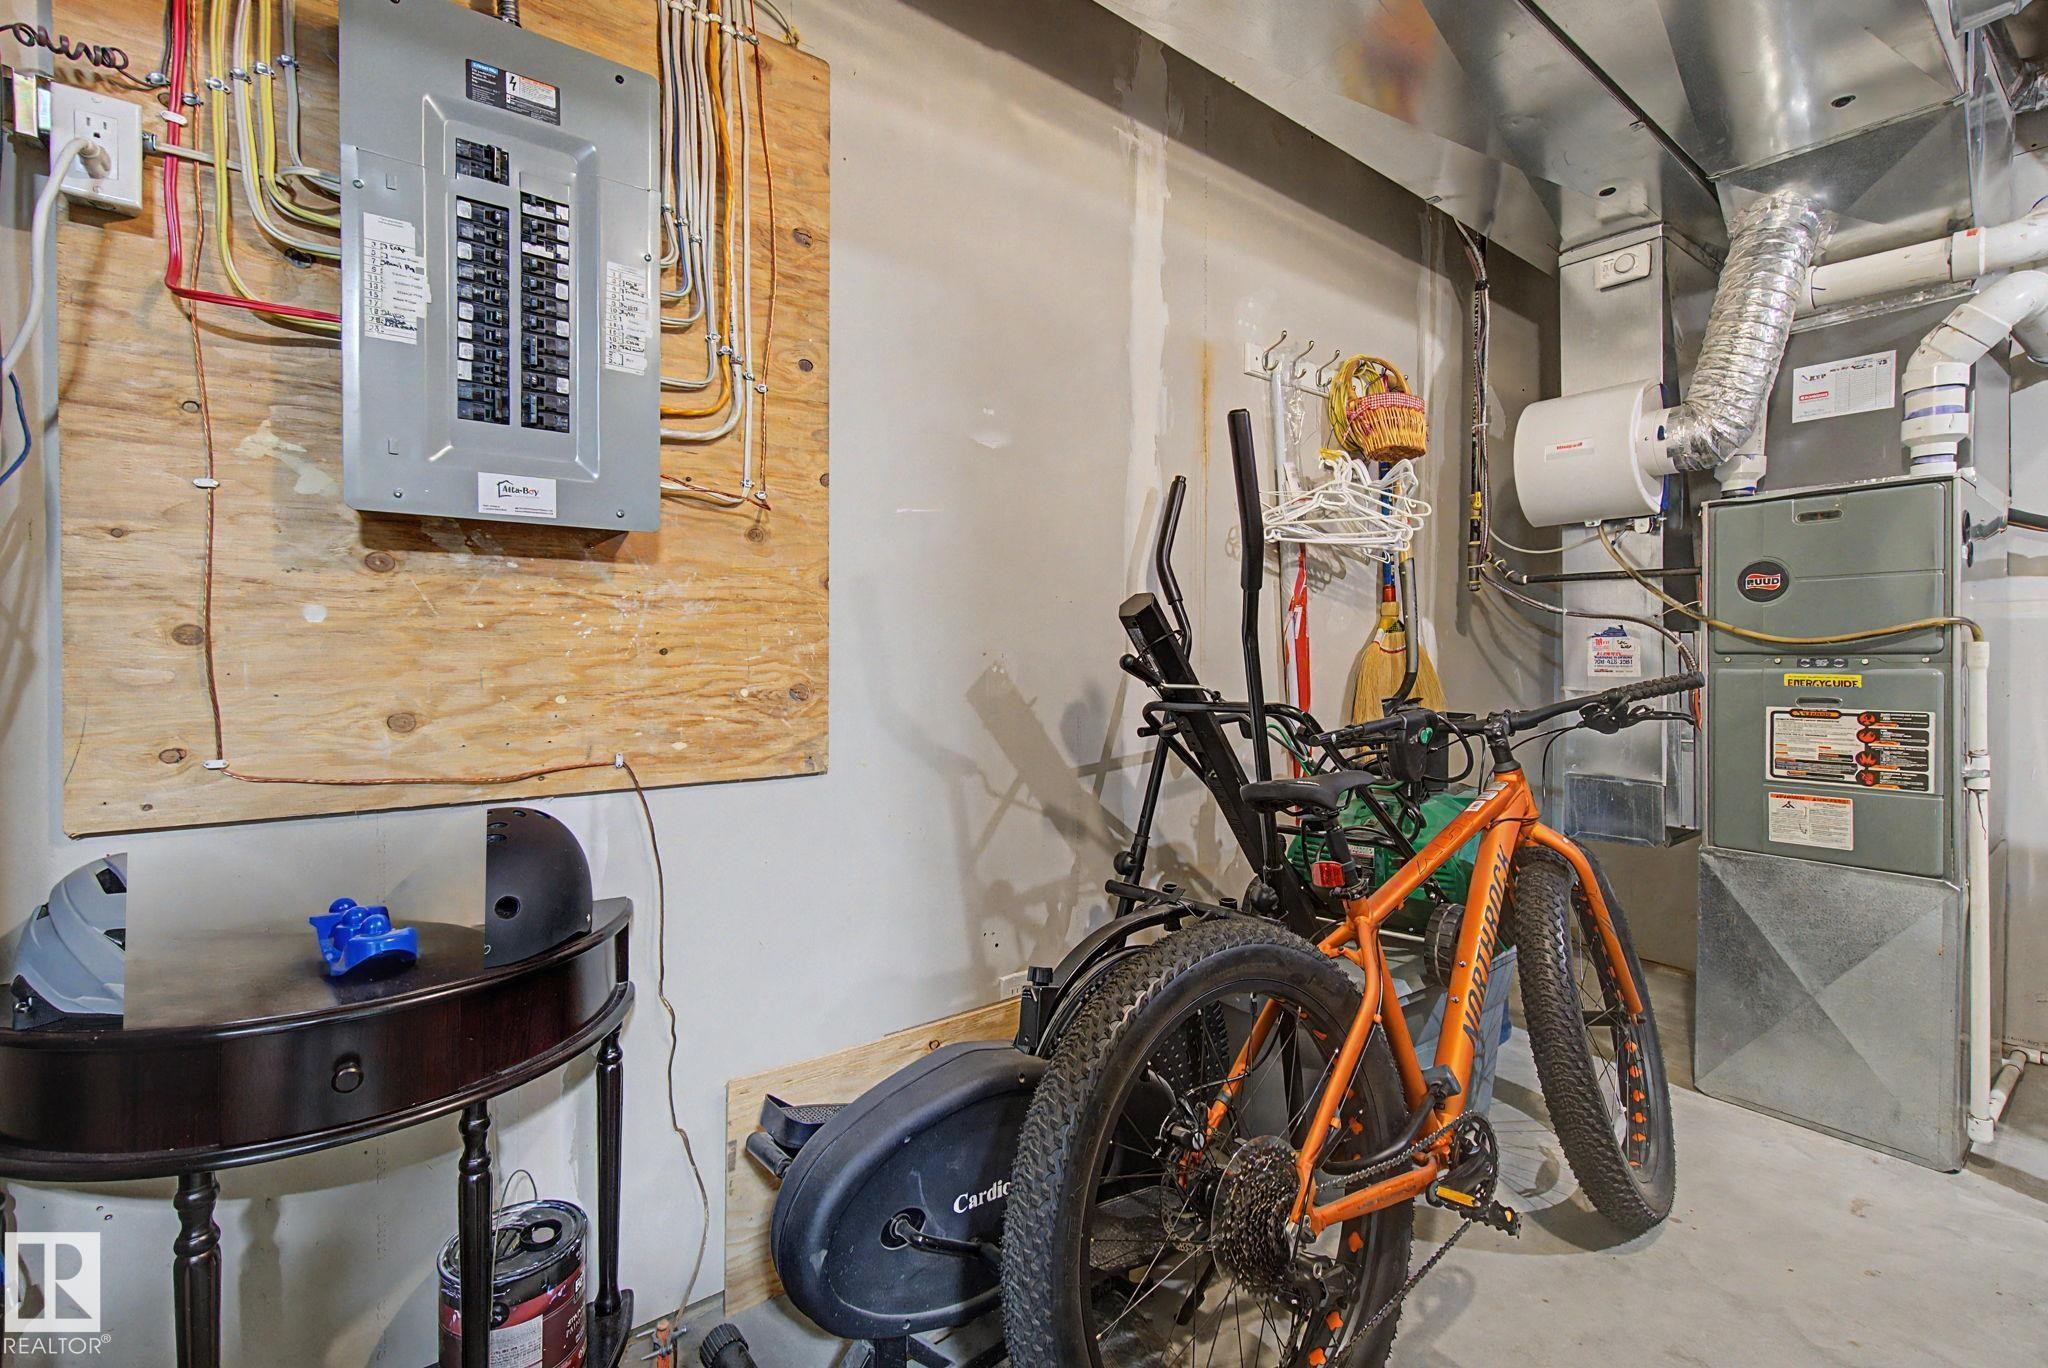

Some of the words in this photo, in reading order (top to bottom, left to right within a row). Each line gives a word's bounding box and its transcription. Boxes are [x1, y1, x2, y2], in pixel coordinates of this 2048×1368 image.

[1746, 577, 1780, 586] RUUD
[1787, 678, 1859, 688] ENERGYGUIDE
[1463, 844, 1511, 1048] NORTHROCK
